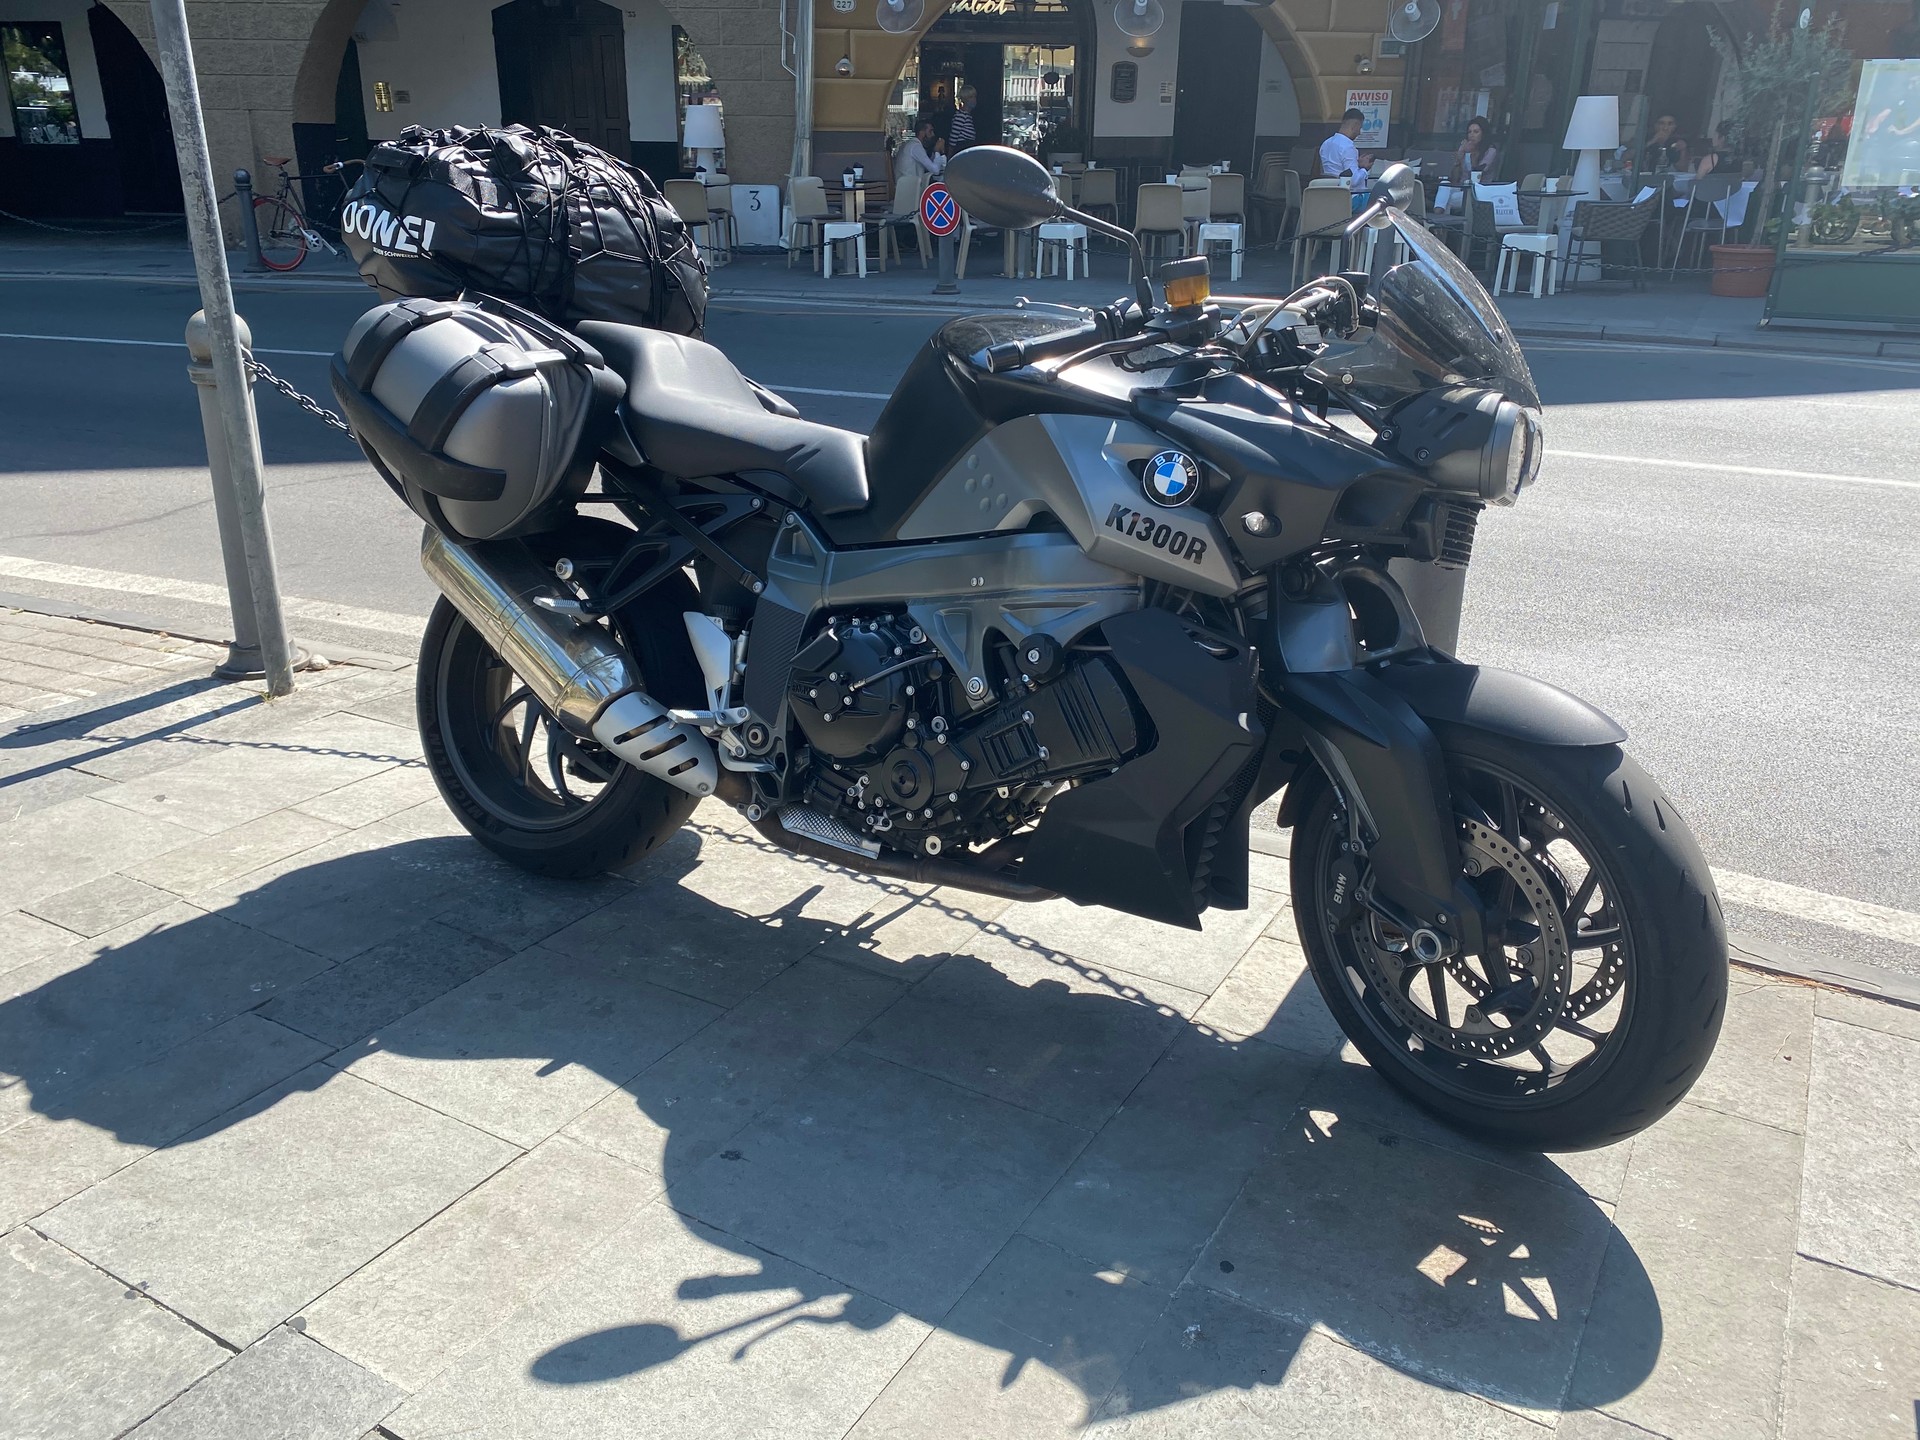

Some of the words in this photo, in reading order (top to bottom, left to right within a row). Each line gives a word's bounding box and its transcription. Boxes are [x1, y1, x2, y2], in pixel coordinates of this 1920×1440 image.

[836, 0, 852, 8] 227
[1350, 92, 1389, 101] AVVISO
[749, 190, 761, 212] 3
[1154, 453, 1197, 477] BMW
[1104, 502, 1208, 565] K1300R
[428, 733, 485, 820] MICHELIN
[1333, 872, 1348, 905] BMW
